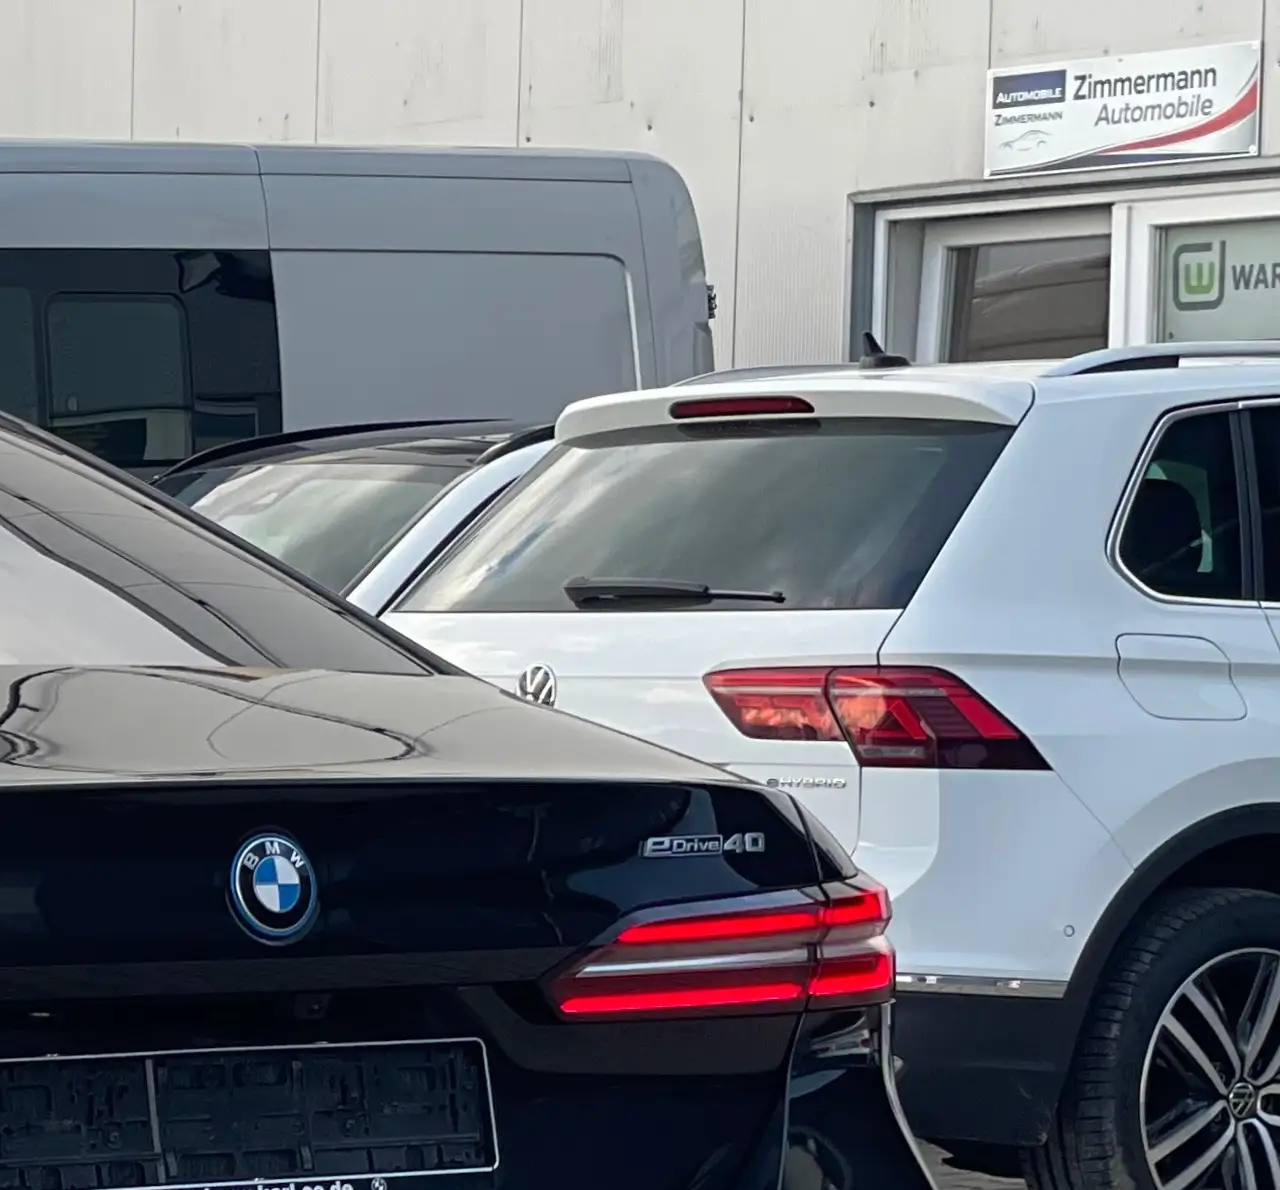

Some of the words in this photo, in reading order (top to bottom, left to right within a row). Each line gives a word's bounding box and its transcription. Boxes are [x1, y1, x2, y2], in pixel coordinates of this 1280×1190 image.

[996, 87, 1063, 104] AUTOMOBILE
[1073, 67, 1217, 101] Zimmermann
[994, 111, 1063, 127] ZIMMERMANN
[1094, 96, 1214, 127] Automobile
[243, 841, 305, 870] BMW
